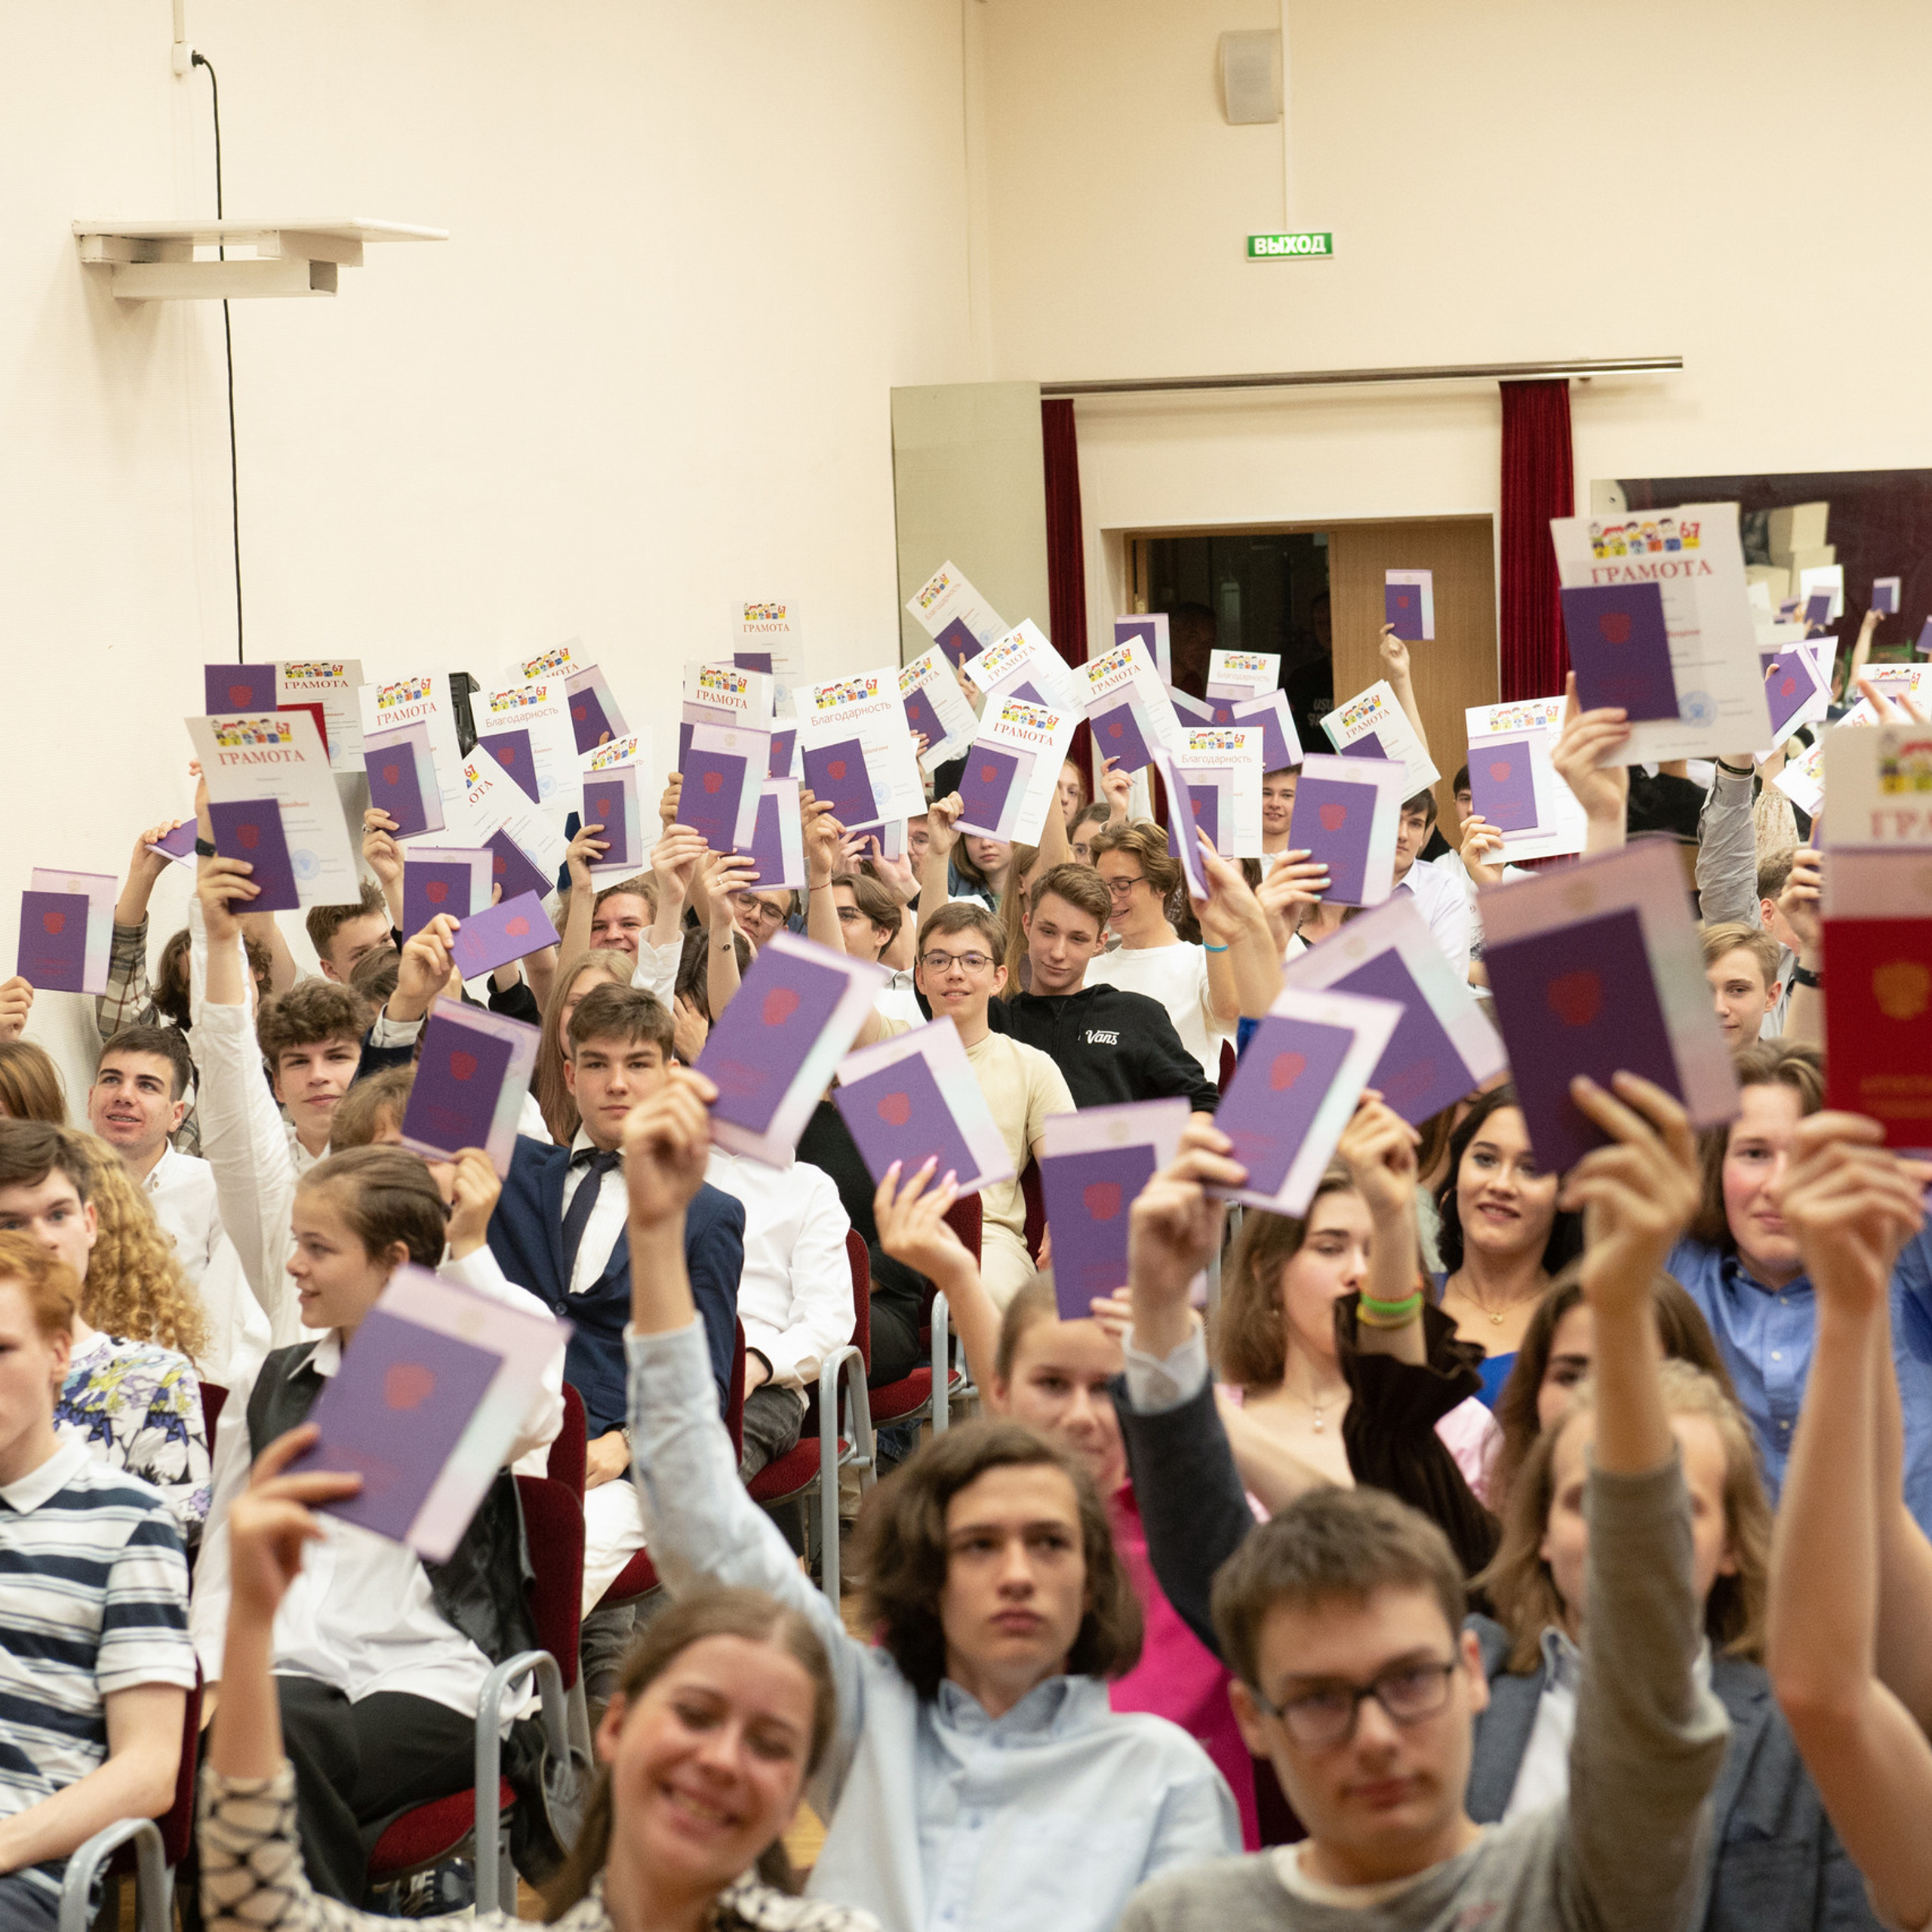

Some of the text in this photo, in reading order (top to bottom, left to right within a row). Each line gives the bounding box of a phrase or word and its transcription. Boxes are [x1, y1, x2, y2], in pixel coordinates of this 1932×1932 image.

[1254, 235, 1327, 254] ВЫХОД
[1680, 521, 1700, 538] 67
[1591, 559, 1712, 584] ГРАМОТА
[778, 605, 786, 614] 67
[743, 623, 790, 632] ГРАМОТА
[1013, 632, 1023, 643] 67
[559, 648, 569, 657] 67
[1122, 648, 1131, 658] 67
[923, 657, 931, 666] 67
[989, 645, 1036, 681] ГРАМОТА
[332, 664, 343, 672] 67
[421, 678, 431, 690] 67
[737, 677, 747, 688] 67
[1091, 664, 1140, 694] ГРАМОТА
[1911, 672, 1921, 685] 67
[285, 680, 349, 689] ГРАМОТА
[866, 679, 877, 690] 67
[536, 686, 547, 696] 67
[697, 689, 748, 709] ГРАМОТА
[1371, 695, 1380, 703] 67
[377, 703, 437, 725] ГРАМОТА
[811, 702, 891, 727] Благодарность
[1545, 706, 1558, 716] 67
[485, 707, 558, 728] Благодарность
[1047, 715, 1059, 724] 67
[275, 721, 291, 735] 67
[1346, 709, 1390, 738] ГРАМОТА
[994, 722, 1054, 746] ГРАМОТА
[1234, 734, 1244, 743] 67
[629, 738, 638, 749] 67
[218, 750, 306, 765] ГРАМОТА
[1181, 754, 1253, 764] Благодарность
[464, 764, 475, 777] 67
[1085, 1029, 1120, 1046] Vans
